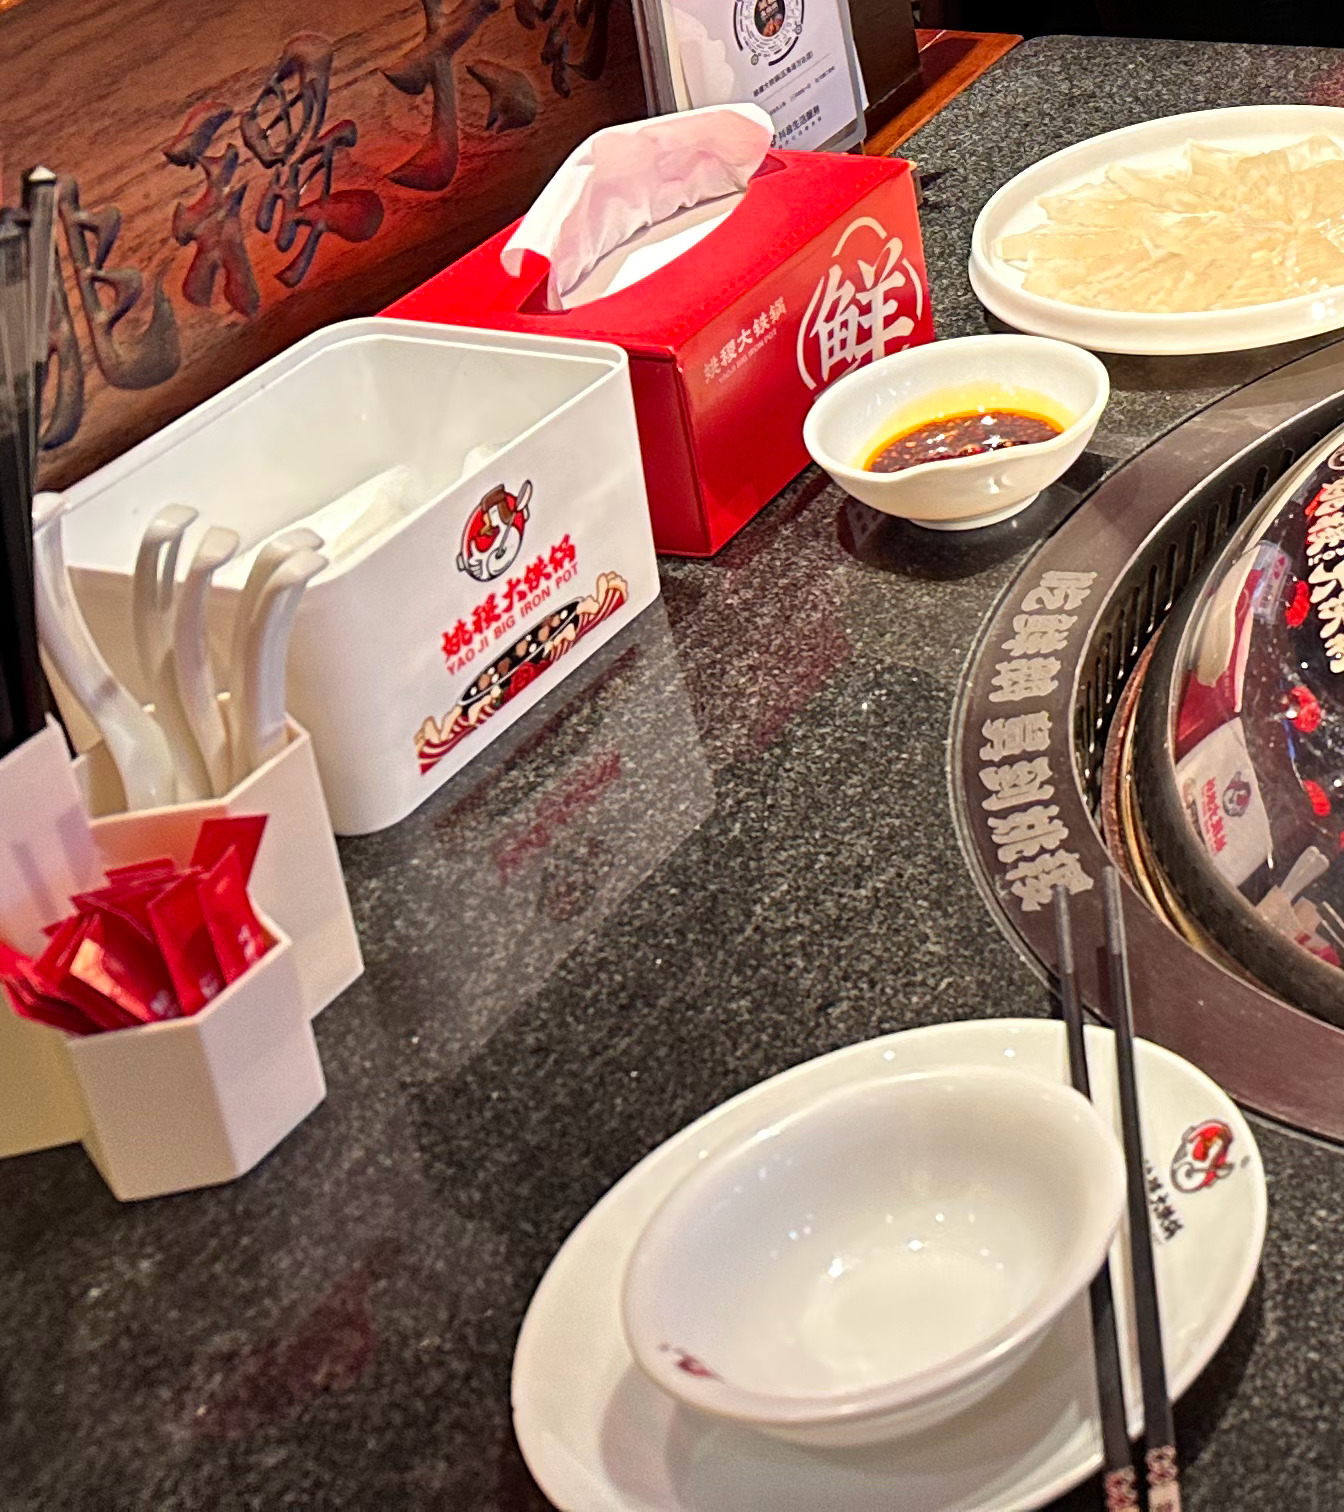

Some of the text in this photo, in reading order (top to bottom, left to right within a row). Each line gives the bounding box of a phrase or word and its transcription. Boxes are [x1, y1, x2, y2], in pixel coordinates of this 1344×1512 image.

[808, 236, 916, 382] 鲜
[494, 617, 517, 641] BIG
[519, 585, 551, 618] IRON
[554, 562, 580, 591] POT
